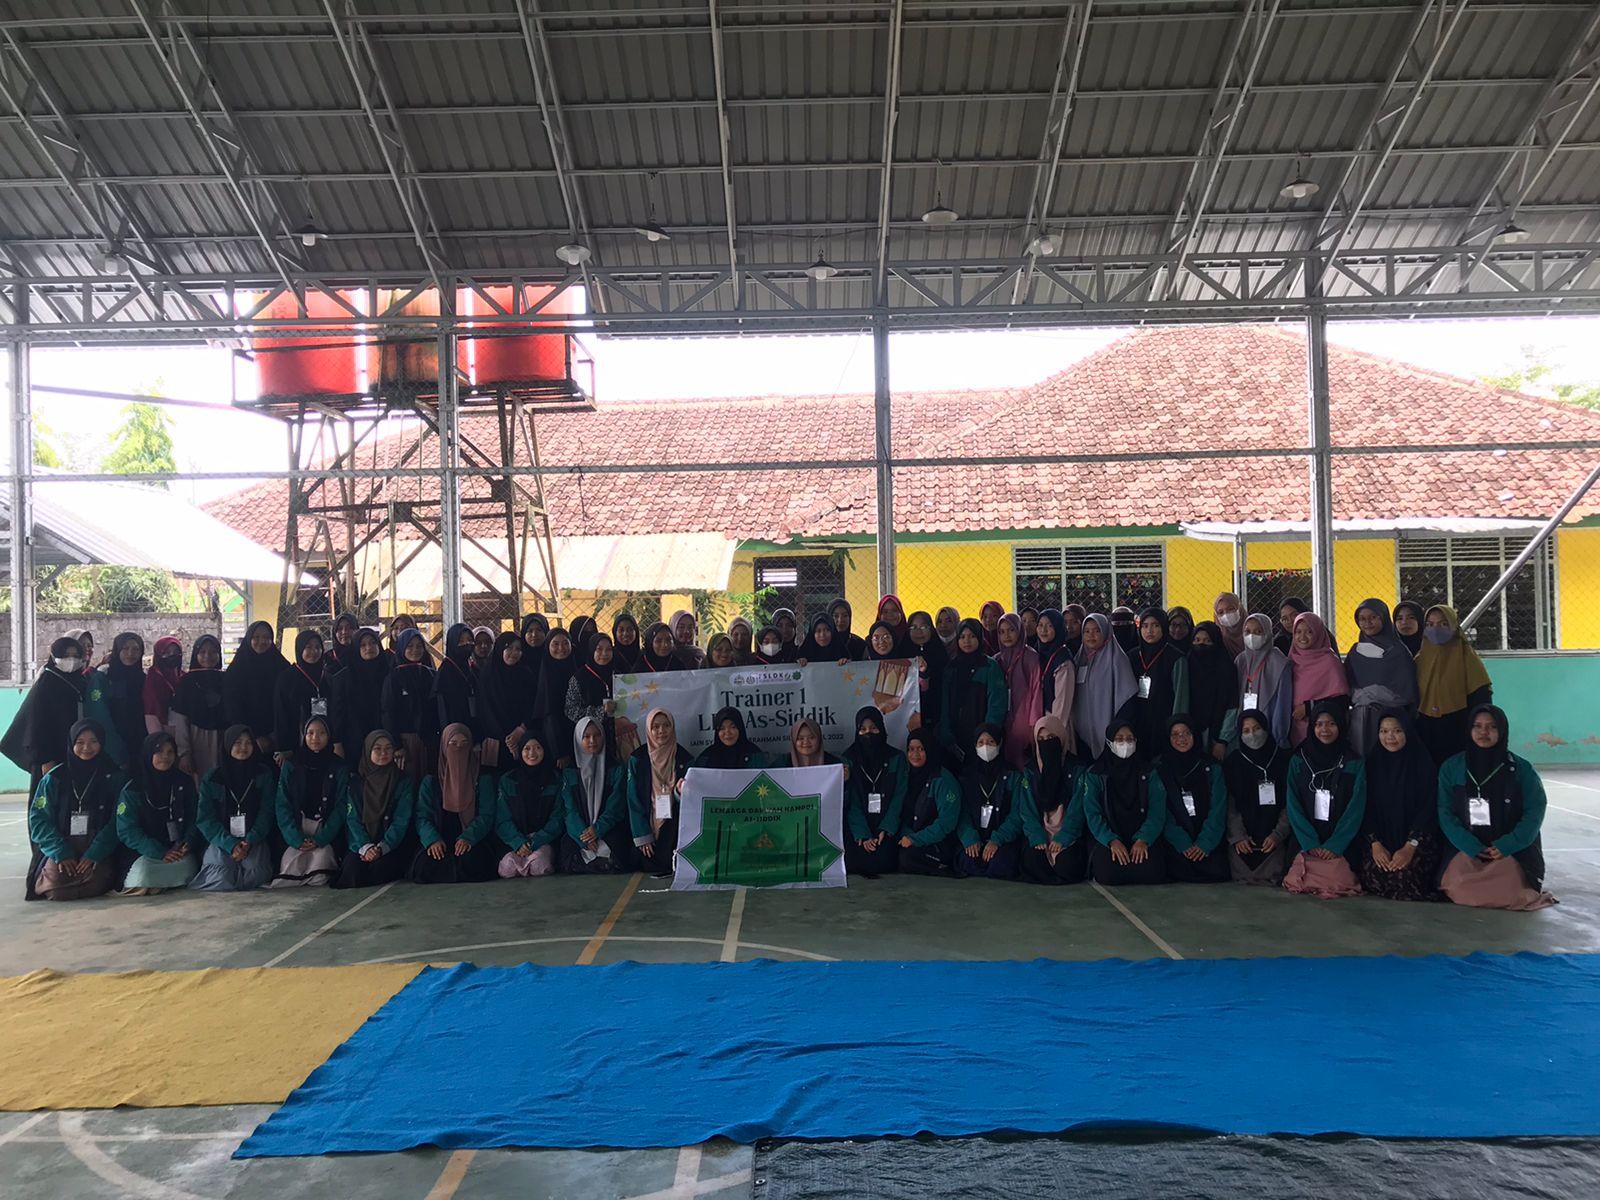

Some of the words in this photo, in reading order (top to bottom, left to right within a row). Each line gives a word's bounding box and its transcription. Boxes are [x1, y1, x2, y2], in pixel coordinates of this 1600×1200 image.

[720, 689, 794, 707] Trainer
[800, 688, 806, 704] 1
[745, 706, 837, 729] As-Siddik
